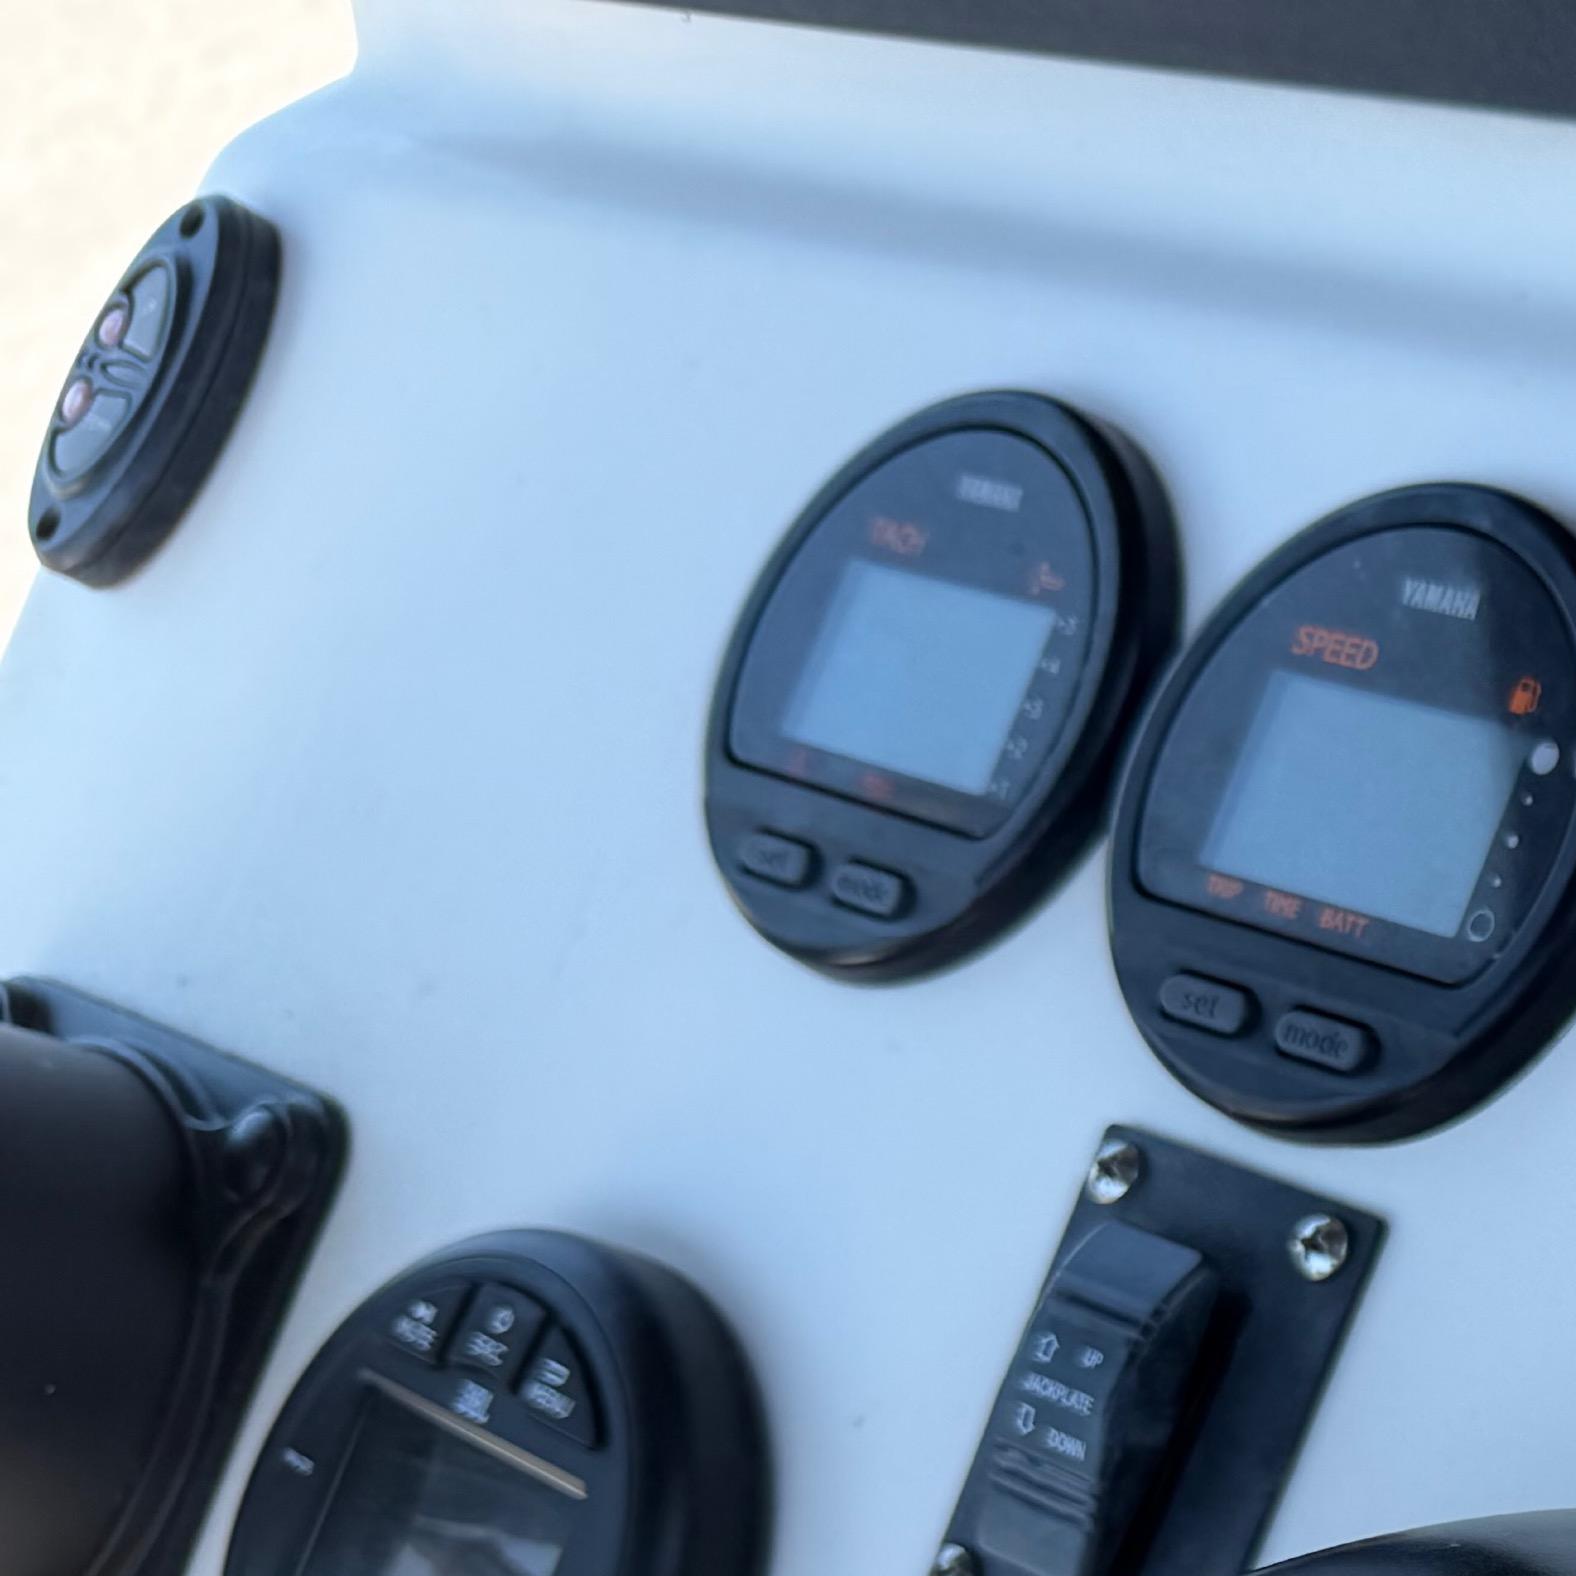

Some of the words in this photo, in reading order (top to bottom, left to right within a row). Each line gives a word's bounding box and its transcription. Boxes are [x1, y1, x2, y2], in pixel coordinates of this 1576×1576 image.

[1402, 576, 1480, 622] YAMAHA
[1291, 625, 1380, 670] SPEED
[1317, 906, 1371, 938] BATT
[1183, 991, 1220, 1020] set
[1284, 1022, 1348, 1058] mode
[1081, 1346, 1105, 1369] UP
[1022, 1370, 1095, 1417] JACKPLATE
[1047, 1426, 1087, 1461] DOWN
